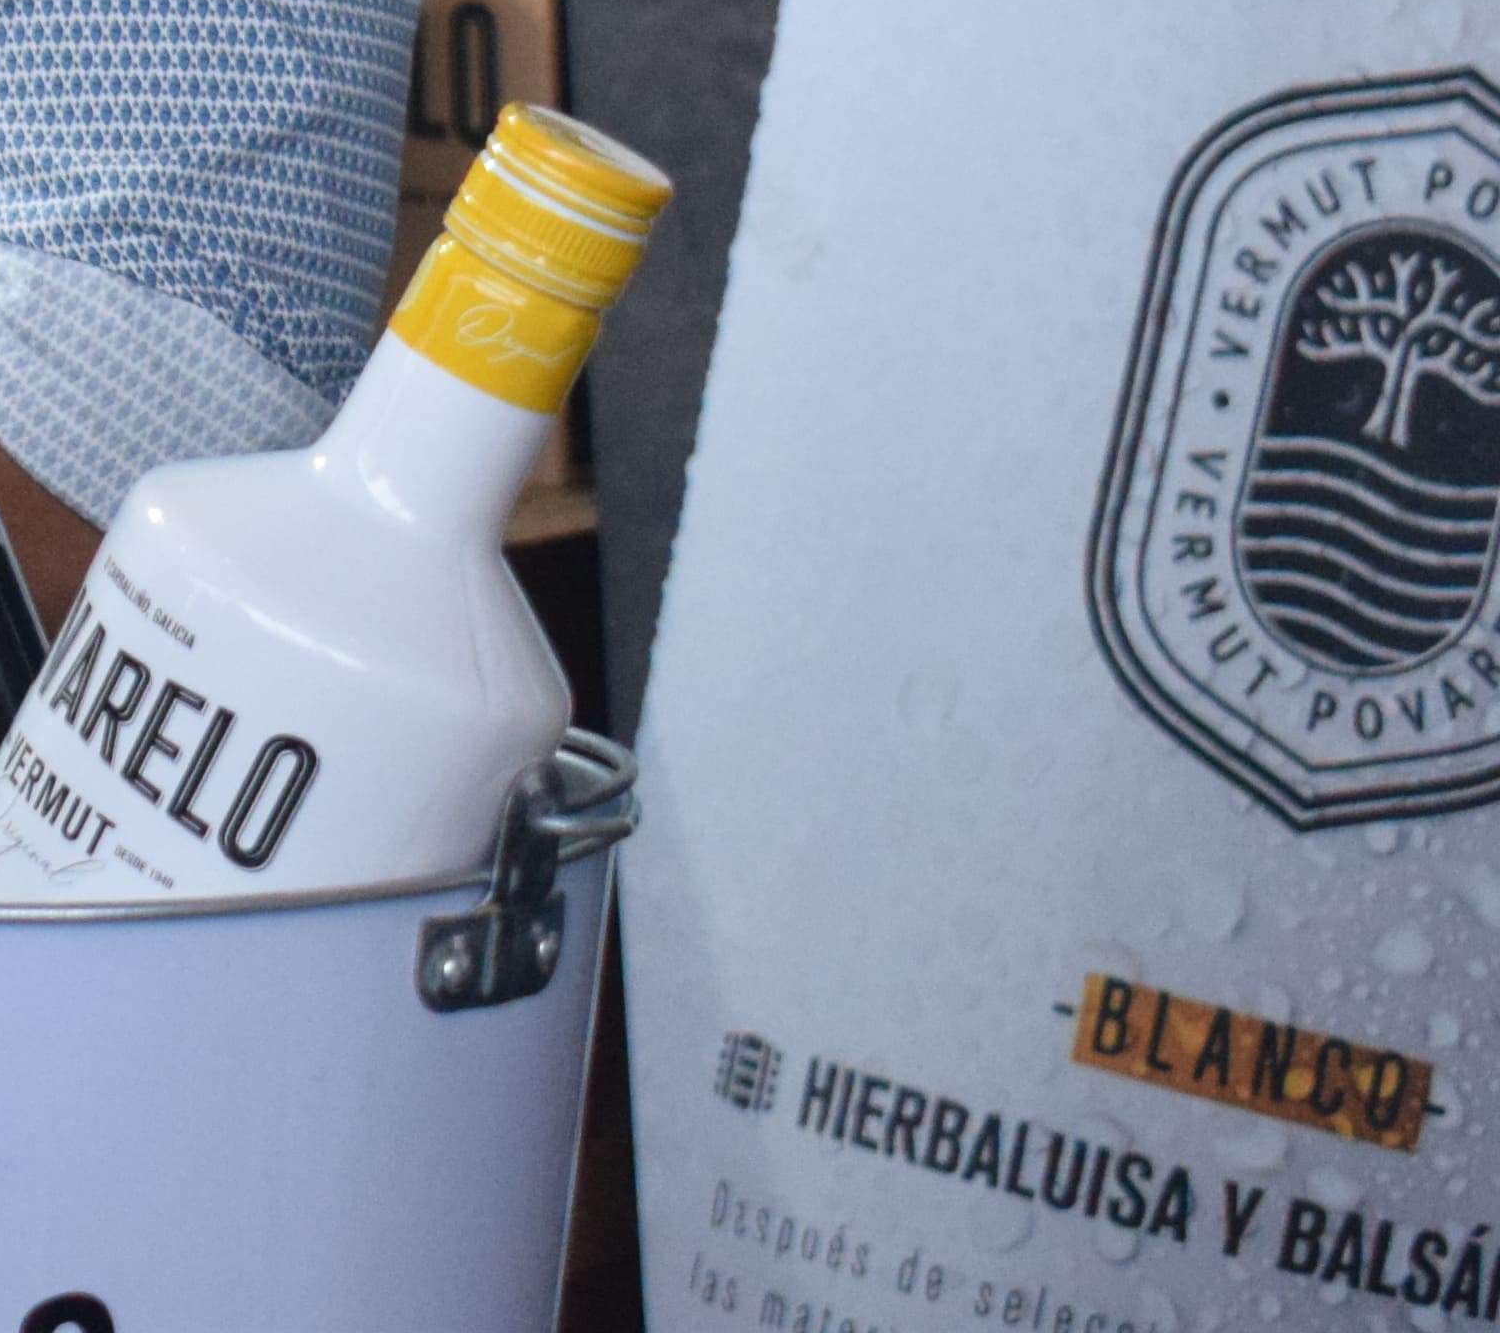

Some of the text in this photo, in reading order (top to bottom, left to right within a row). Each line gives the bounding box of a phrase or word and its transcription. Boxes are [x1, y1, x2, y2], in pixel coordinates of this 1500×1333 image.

[1210, 156, 1377, 360] VERMUT
[152, 607, 196, 650] GALICIA
[1171, 440, 1279, 699] VERMUT
[3, 733, 117, 857] VERMUT
[796, 1056, 1193, 1244] HIERBALUISA
[1222, 1180, 1265, 1257] Y
[690, 1251, 739, 1313] las
[710, 1178, 871, 1279] Después
[897, 1249, 946, 1303] de
